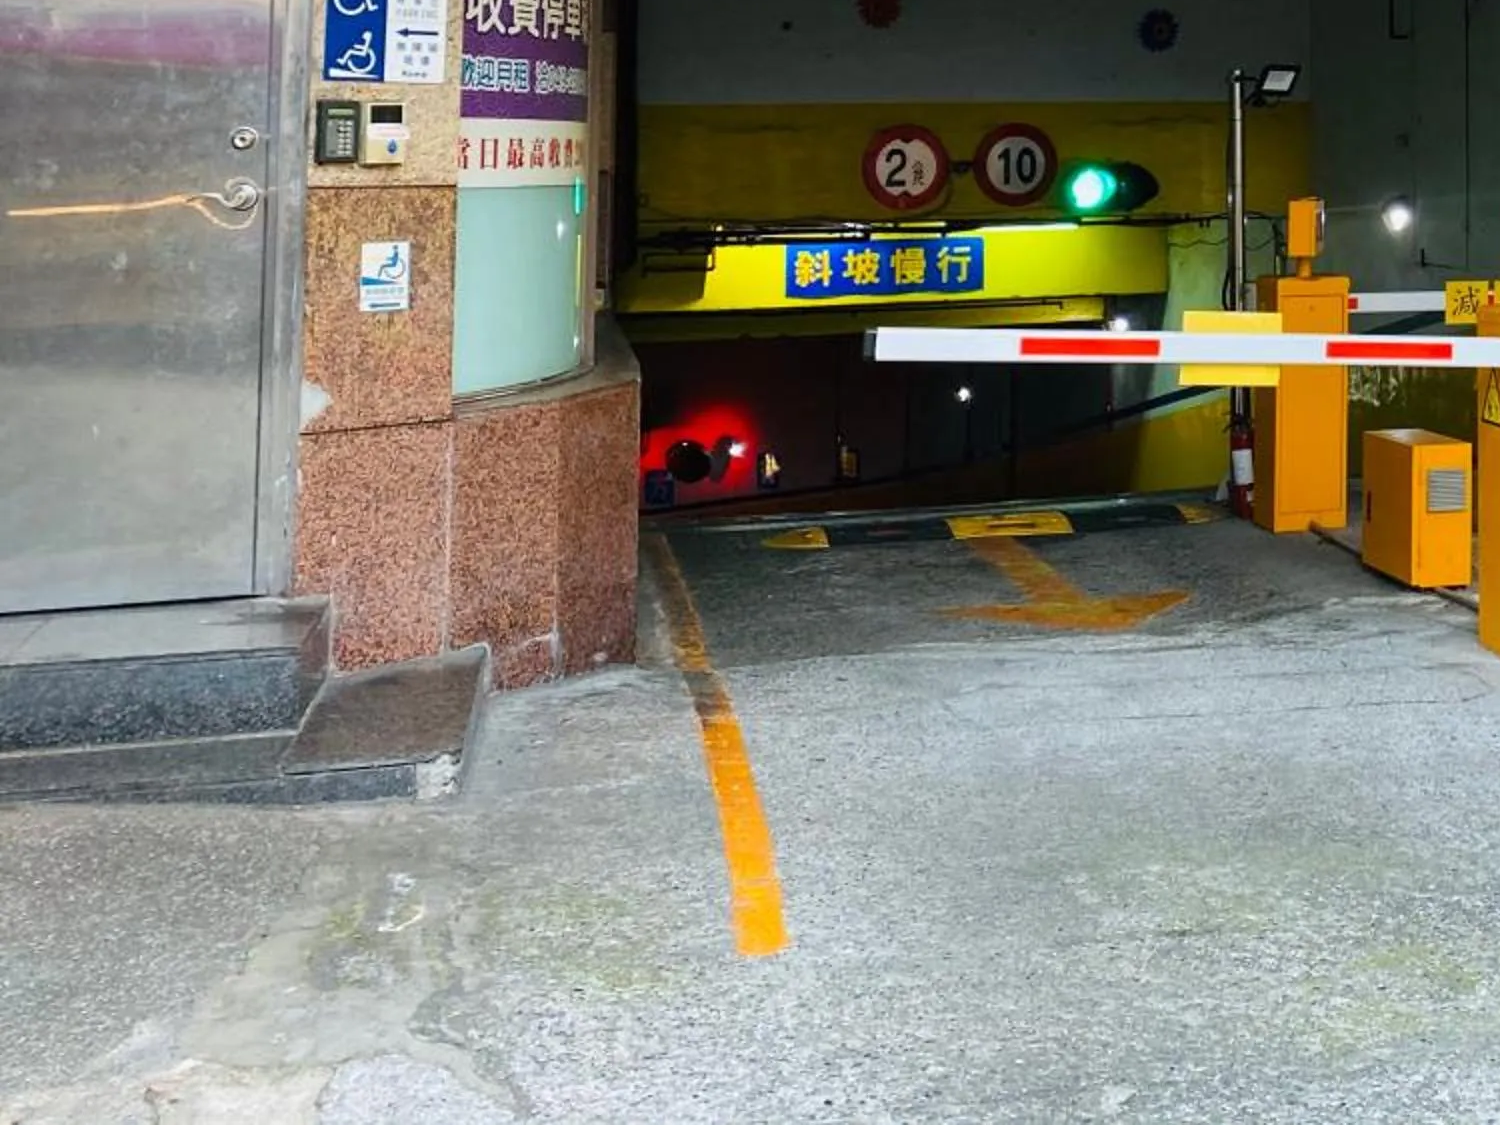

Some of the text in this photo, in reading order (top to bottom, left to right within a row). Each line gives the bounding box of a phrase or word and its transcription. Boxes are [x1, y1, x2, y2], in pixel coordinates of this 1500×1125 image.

[884, 148, 907, 187] 2
[997, 146, 1037, 185] 10
[793, 246, 973, 288] 斜坡慢行
